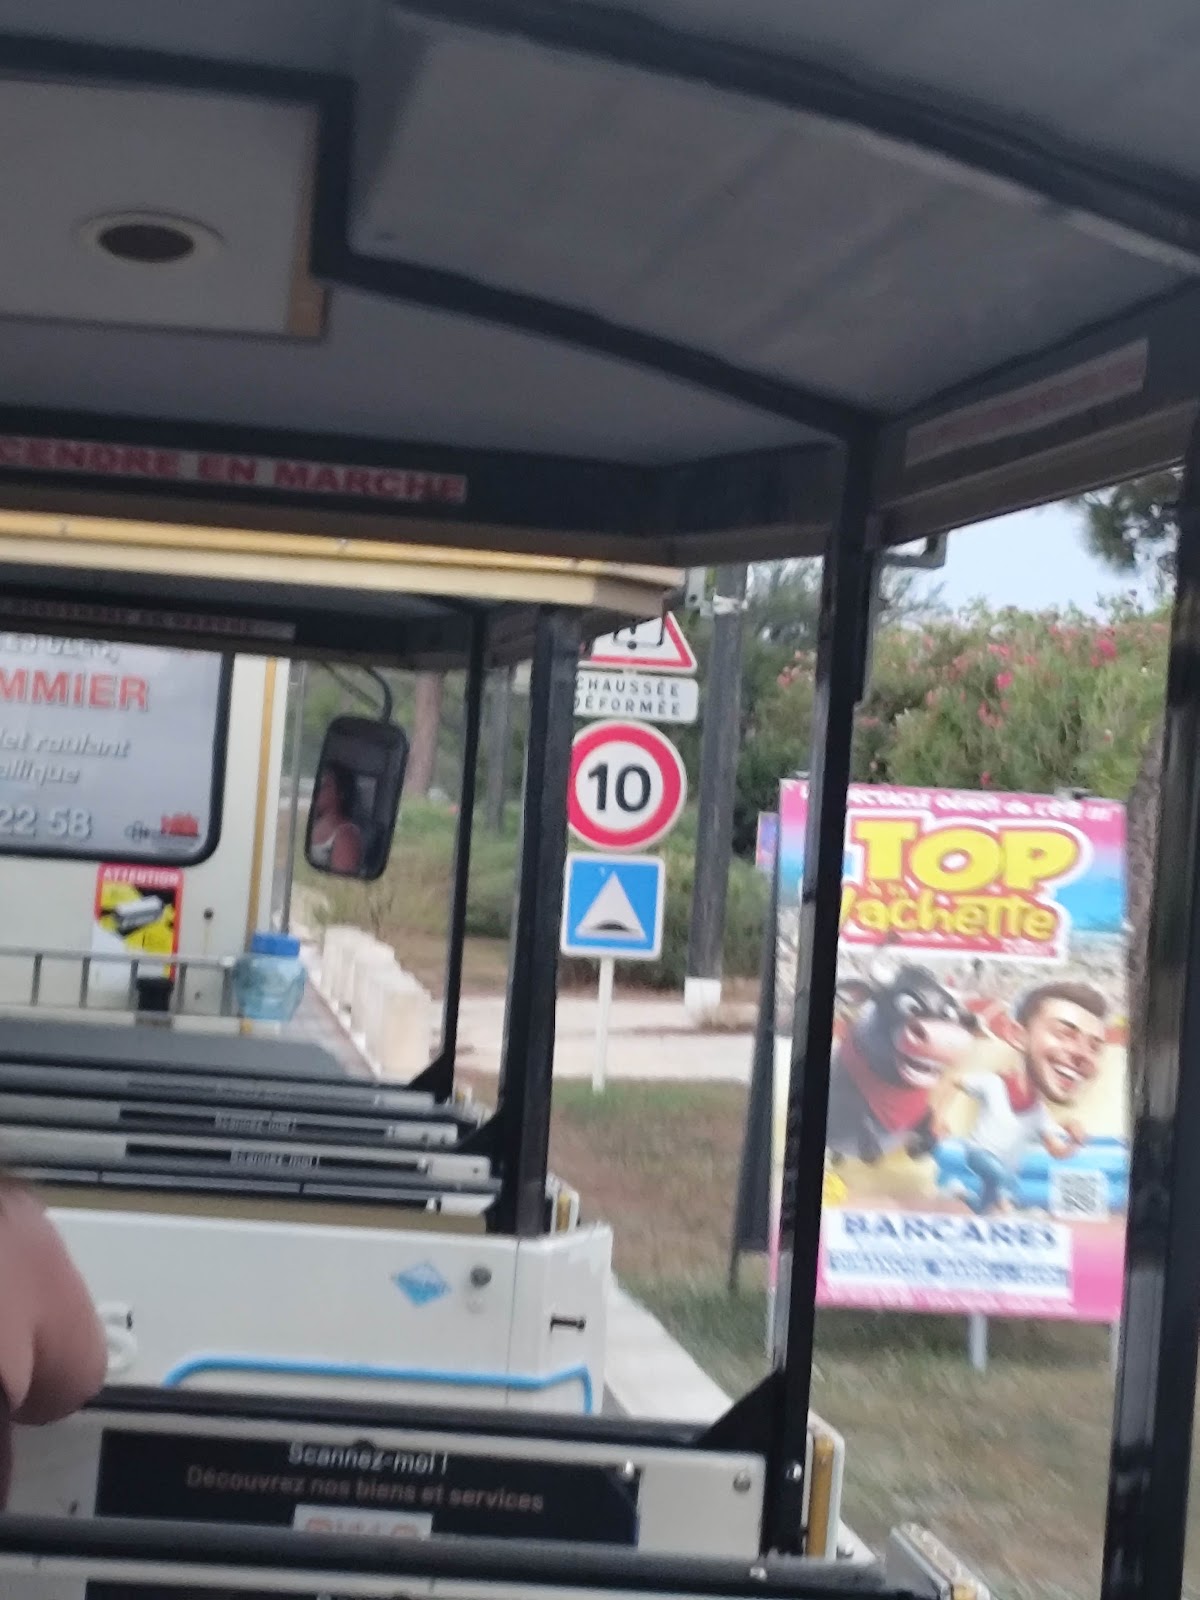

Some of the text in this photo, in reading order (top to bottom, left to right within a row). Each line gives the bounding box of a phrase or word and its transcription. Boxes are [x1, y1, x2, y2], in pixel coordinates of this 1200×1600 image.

[199, 456, 257, 482] EN
[273, 463, 465, 499] MARCHE
[0, 667, 149, 713] MMIER
[588, 762, 651, 812] 10
[49, 806, 92, 842] 58
[853, 818, 1081, 893] TOP
[186, 1464, 543, 1514] Découvrez nos biens et services
